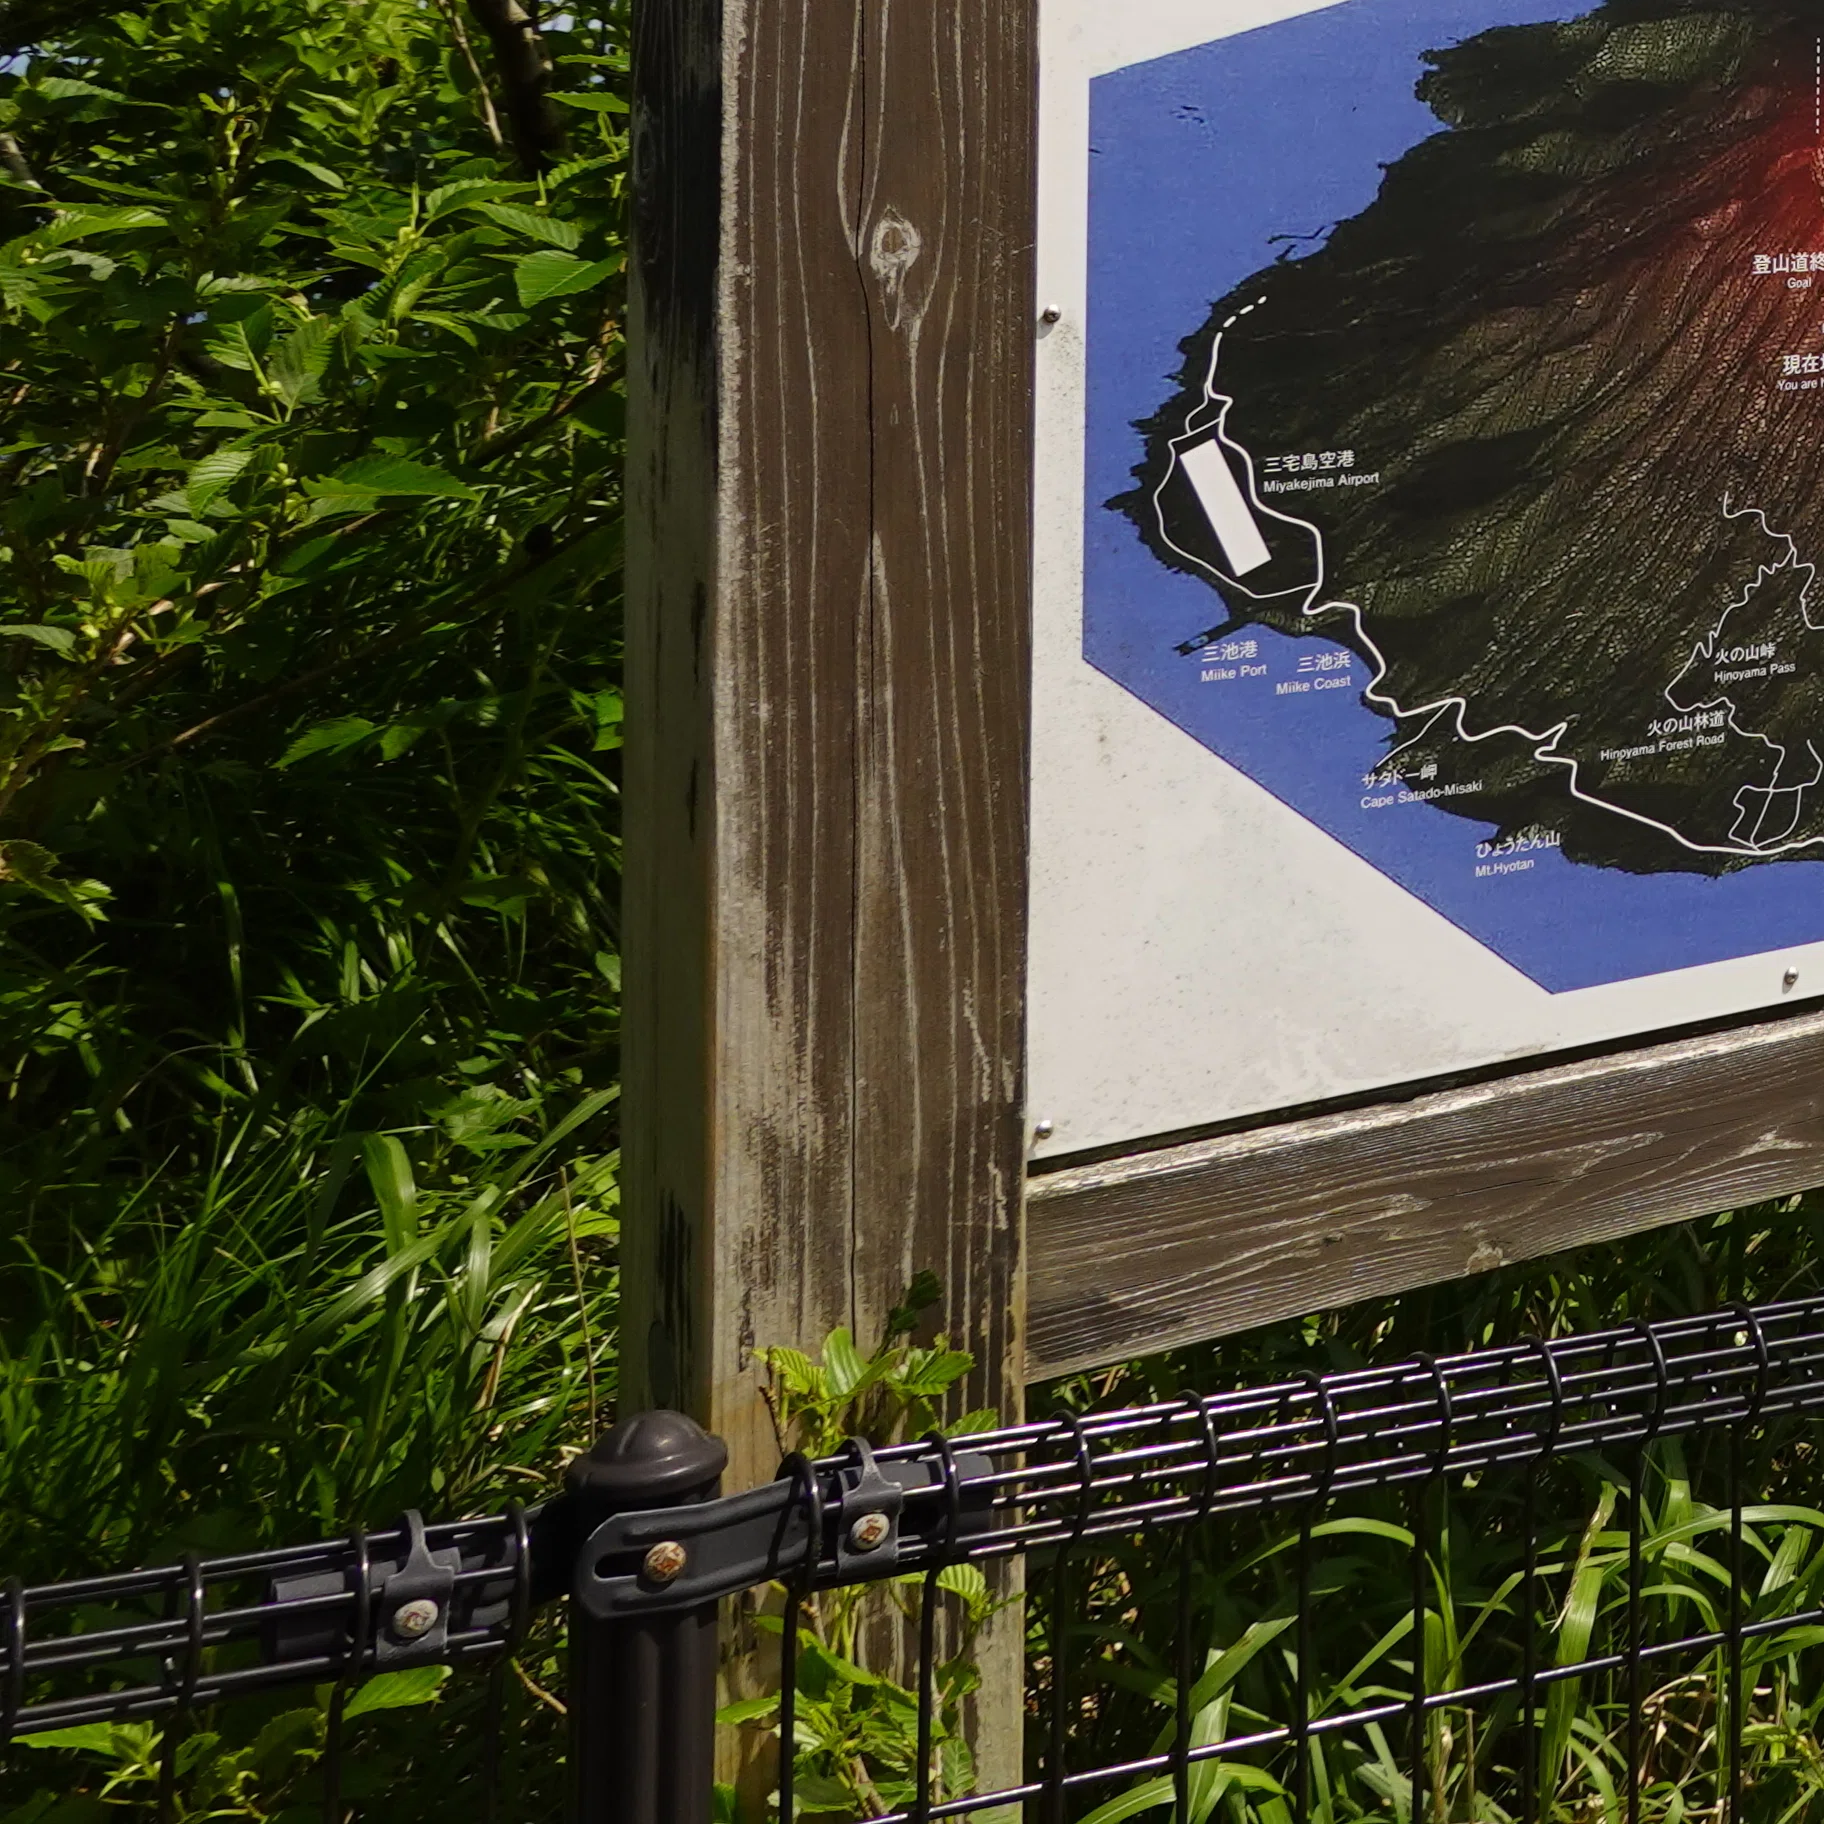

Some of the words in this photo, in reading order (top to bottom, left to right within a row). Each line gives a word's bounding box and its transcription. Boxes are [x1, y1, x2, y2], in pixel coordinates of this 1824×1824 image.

[1787, 277, 1812, 288] Goal
[1777, 380, 1798, 391] You
[1800, 380, 1818, 390] are
[1263, 449, 1355, 473] 三宅島空港
[1263, 476, 1335, 494] Miyakejima
[1338, 472, 1380, 487] Airport
[1201, 639, 1259, 662] 三池港
[1714, 642, 1777, 665] 火の山峠
[1201, 667, 1237, 682] Miike
[1240, 664, 1267, 677] Port
[1297, 651, 1351, 673] 三池浜
[1714, 668, 1767, 683] Hinoyama
[1770, 662, 1796, 674] Pass
[1276, 680, 1310, 695] Miike
[1314, 676, 1351, 690] Coast
[1647, 710, 1725, 736] 火の山林道
[1600, 744, 1655, 761] Hinoyama
[1658, 738, 1693, 752] Forest
[1696, 732, 1725, 746] Road
[1361, 763, 1438, 789] サタドー岬
[1360, 795, 1394, 809] Cape
[1398, 779, 1483, 803] Satado-Misaki
[1475, 831, 1561, 858] ひょうたん山
[1475, 858, 1535, 878] Mt.Hyotan
